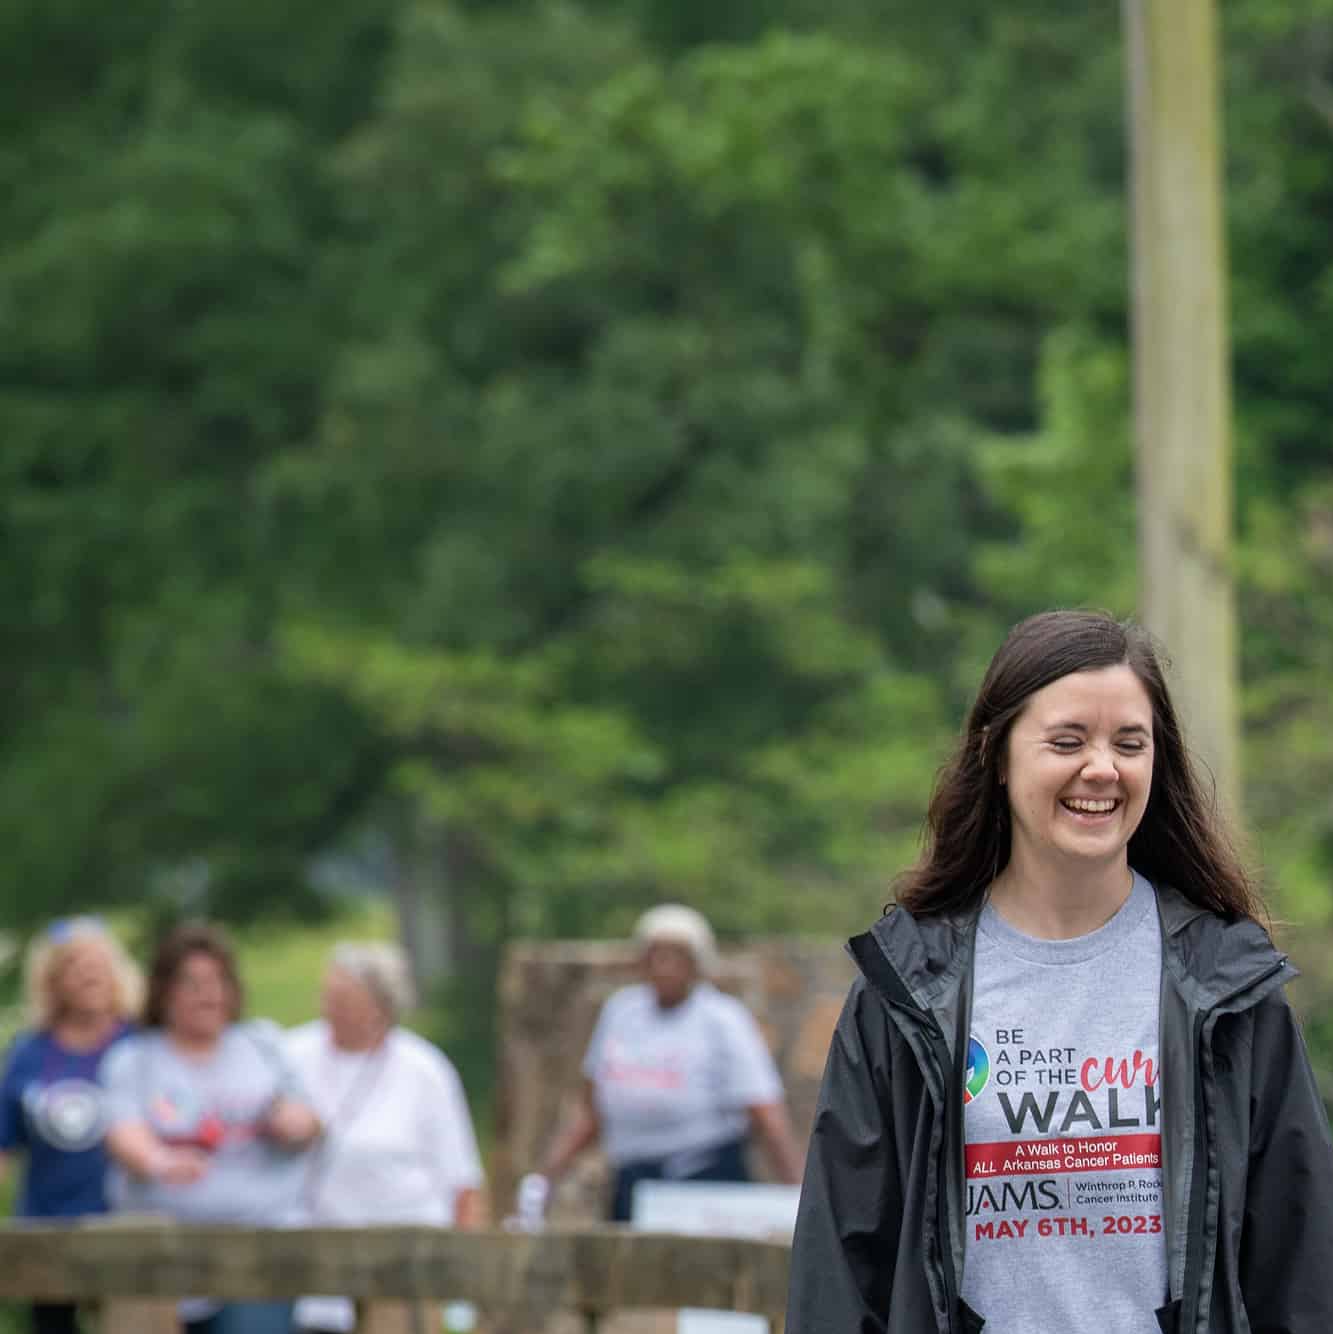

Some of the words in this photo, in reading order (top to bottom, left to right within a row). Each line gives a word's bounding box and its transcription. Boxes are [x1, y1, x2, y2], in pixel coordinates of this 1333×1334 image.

[996, 1029, 1024, 1044] BE
[996, 1050, 1011, 1064] A
[1020, 1048, 1076, 1064] PART
[996, 1070, 1027, 1085] OF
[1034, 1069, 1077, 1085] THE
[1081, 1049, 1160, 1092] cur
[1015, 1144, 1025, 1157] A
[1027, 1143, 1059, 1156] Walk
[1062, 1143, 1075, 1154] to
[1078, 1141, 1118, 1153] Honor
[973, 1160, 996, 1174] ALL
[1003, 1159, 1061, 1171] Arkansas
[1064, 1156, 1109, 1168] Cancer
[1113, 1152, 1159, 1165] Patients
[1075, 1181, 1126, 1192] Winthrop
[1076, 1194, 1113, 1204] Cancer
[1117, 1193, 1159, 1202] Institute
[975, 1219, 1029, 1240] MAY
[1038, 1216, 1095, 1238] 6TH,
[1103, 1215, 1162, 1234] 2023
